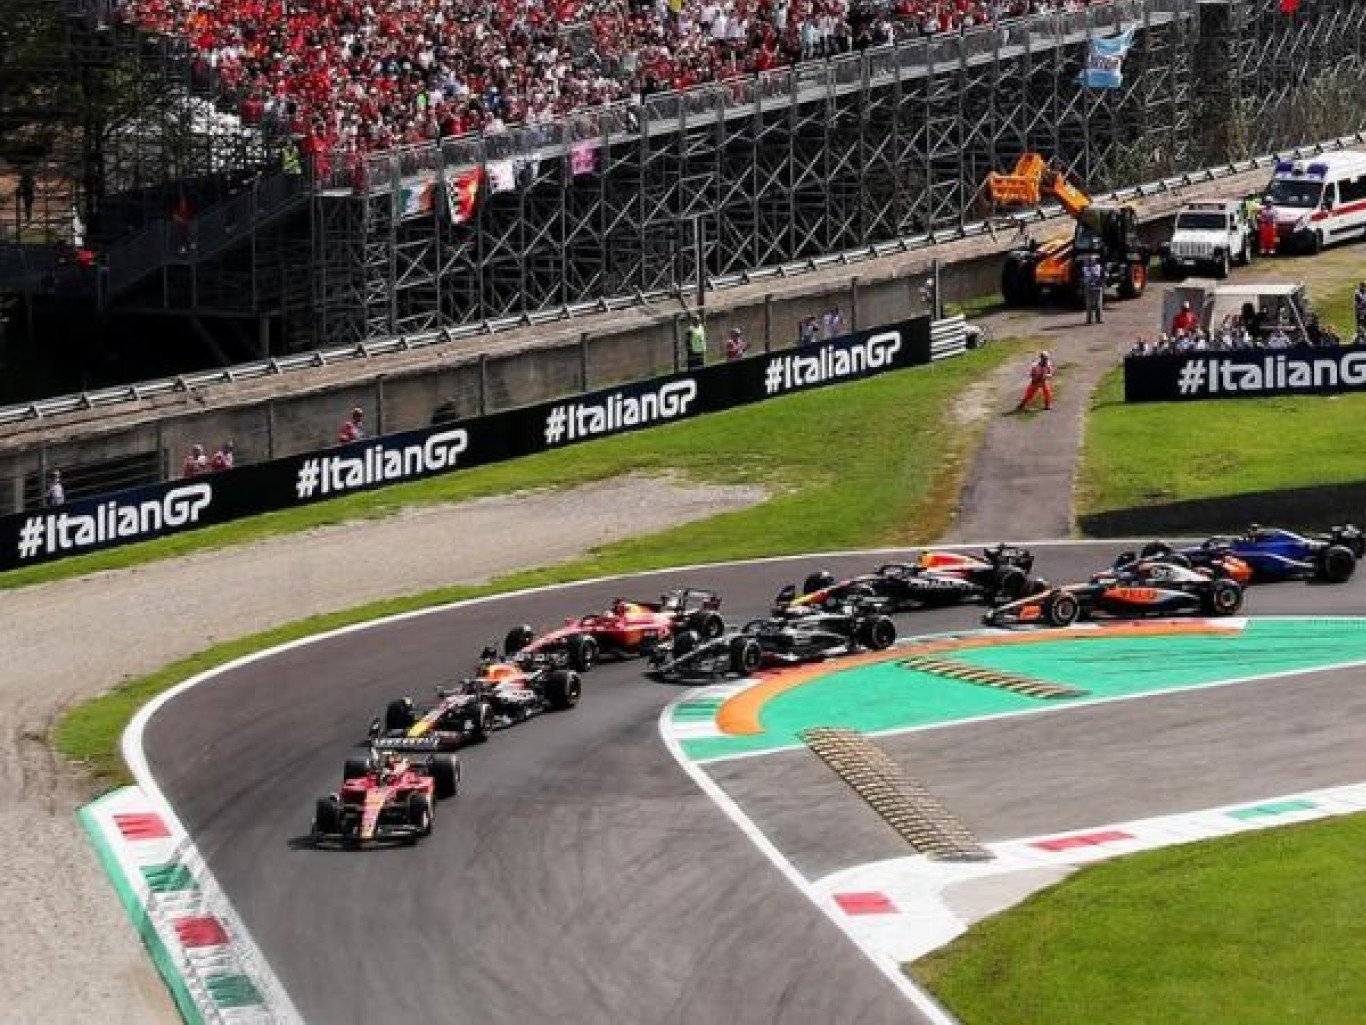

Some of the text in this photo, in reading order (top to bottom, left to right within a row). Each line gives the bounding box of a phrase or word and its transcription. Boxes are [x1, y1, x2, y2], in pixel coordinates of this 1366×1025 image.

[764, 331, 902, 394] #ItalianGP
[544, 378, 698, 443] #ItalianGP
[295, 428, 468, 498] #ItalianGP
[17, 483, 212, 558] #ItalianGP
